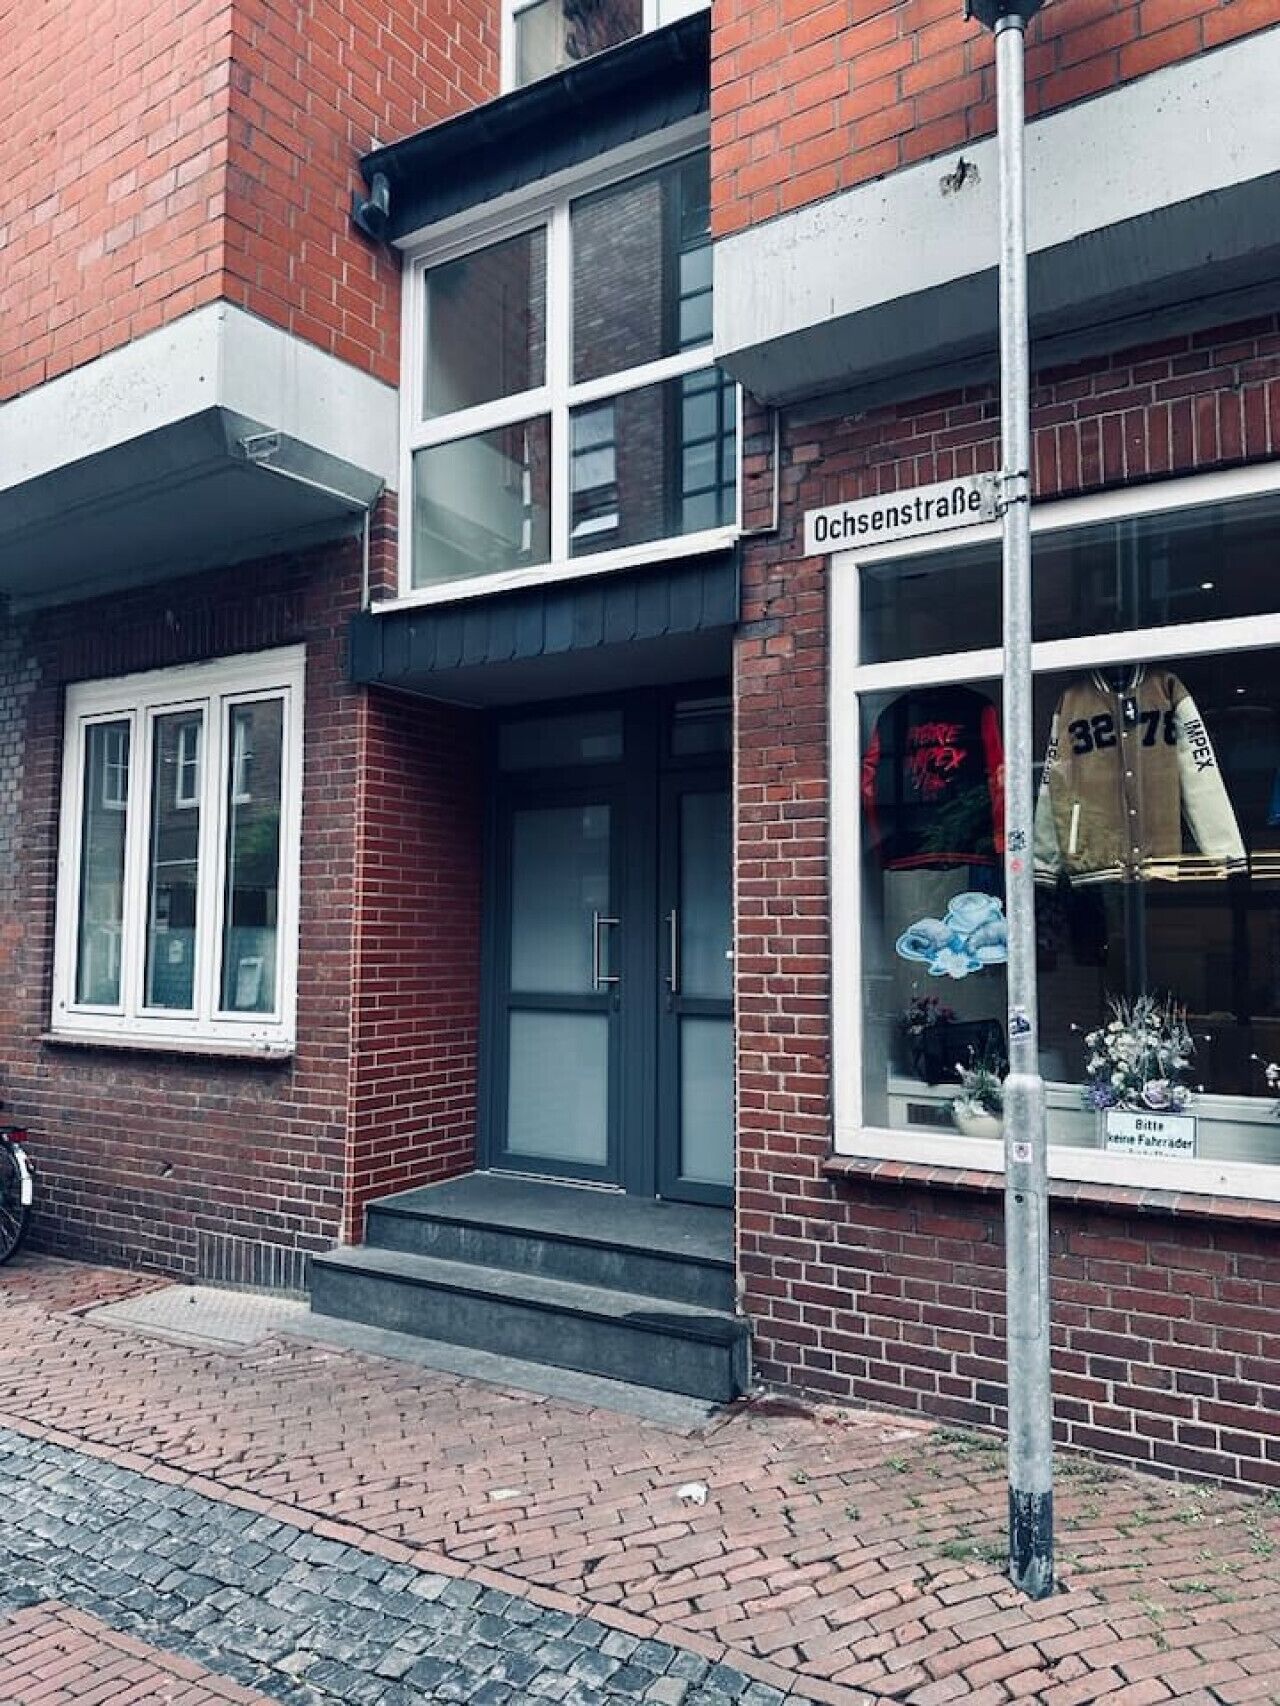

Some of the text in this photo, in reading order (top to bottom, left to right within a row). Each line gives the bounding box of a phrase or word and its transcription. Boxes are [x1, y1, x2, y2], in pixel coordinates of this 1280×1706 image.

[815, 486, 981, 543] Ochsenstraße
[1068, 712, 1117, 755] 32
[1184, 719, 1215, 773] IMPEX
[1135, 1118, 1164, 1131] Bitte
